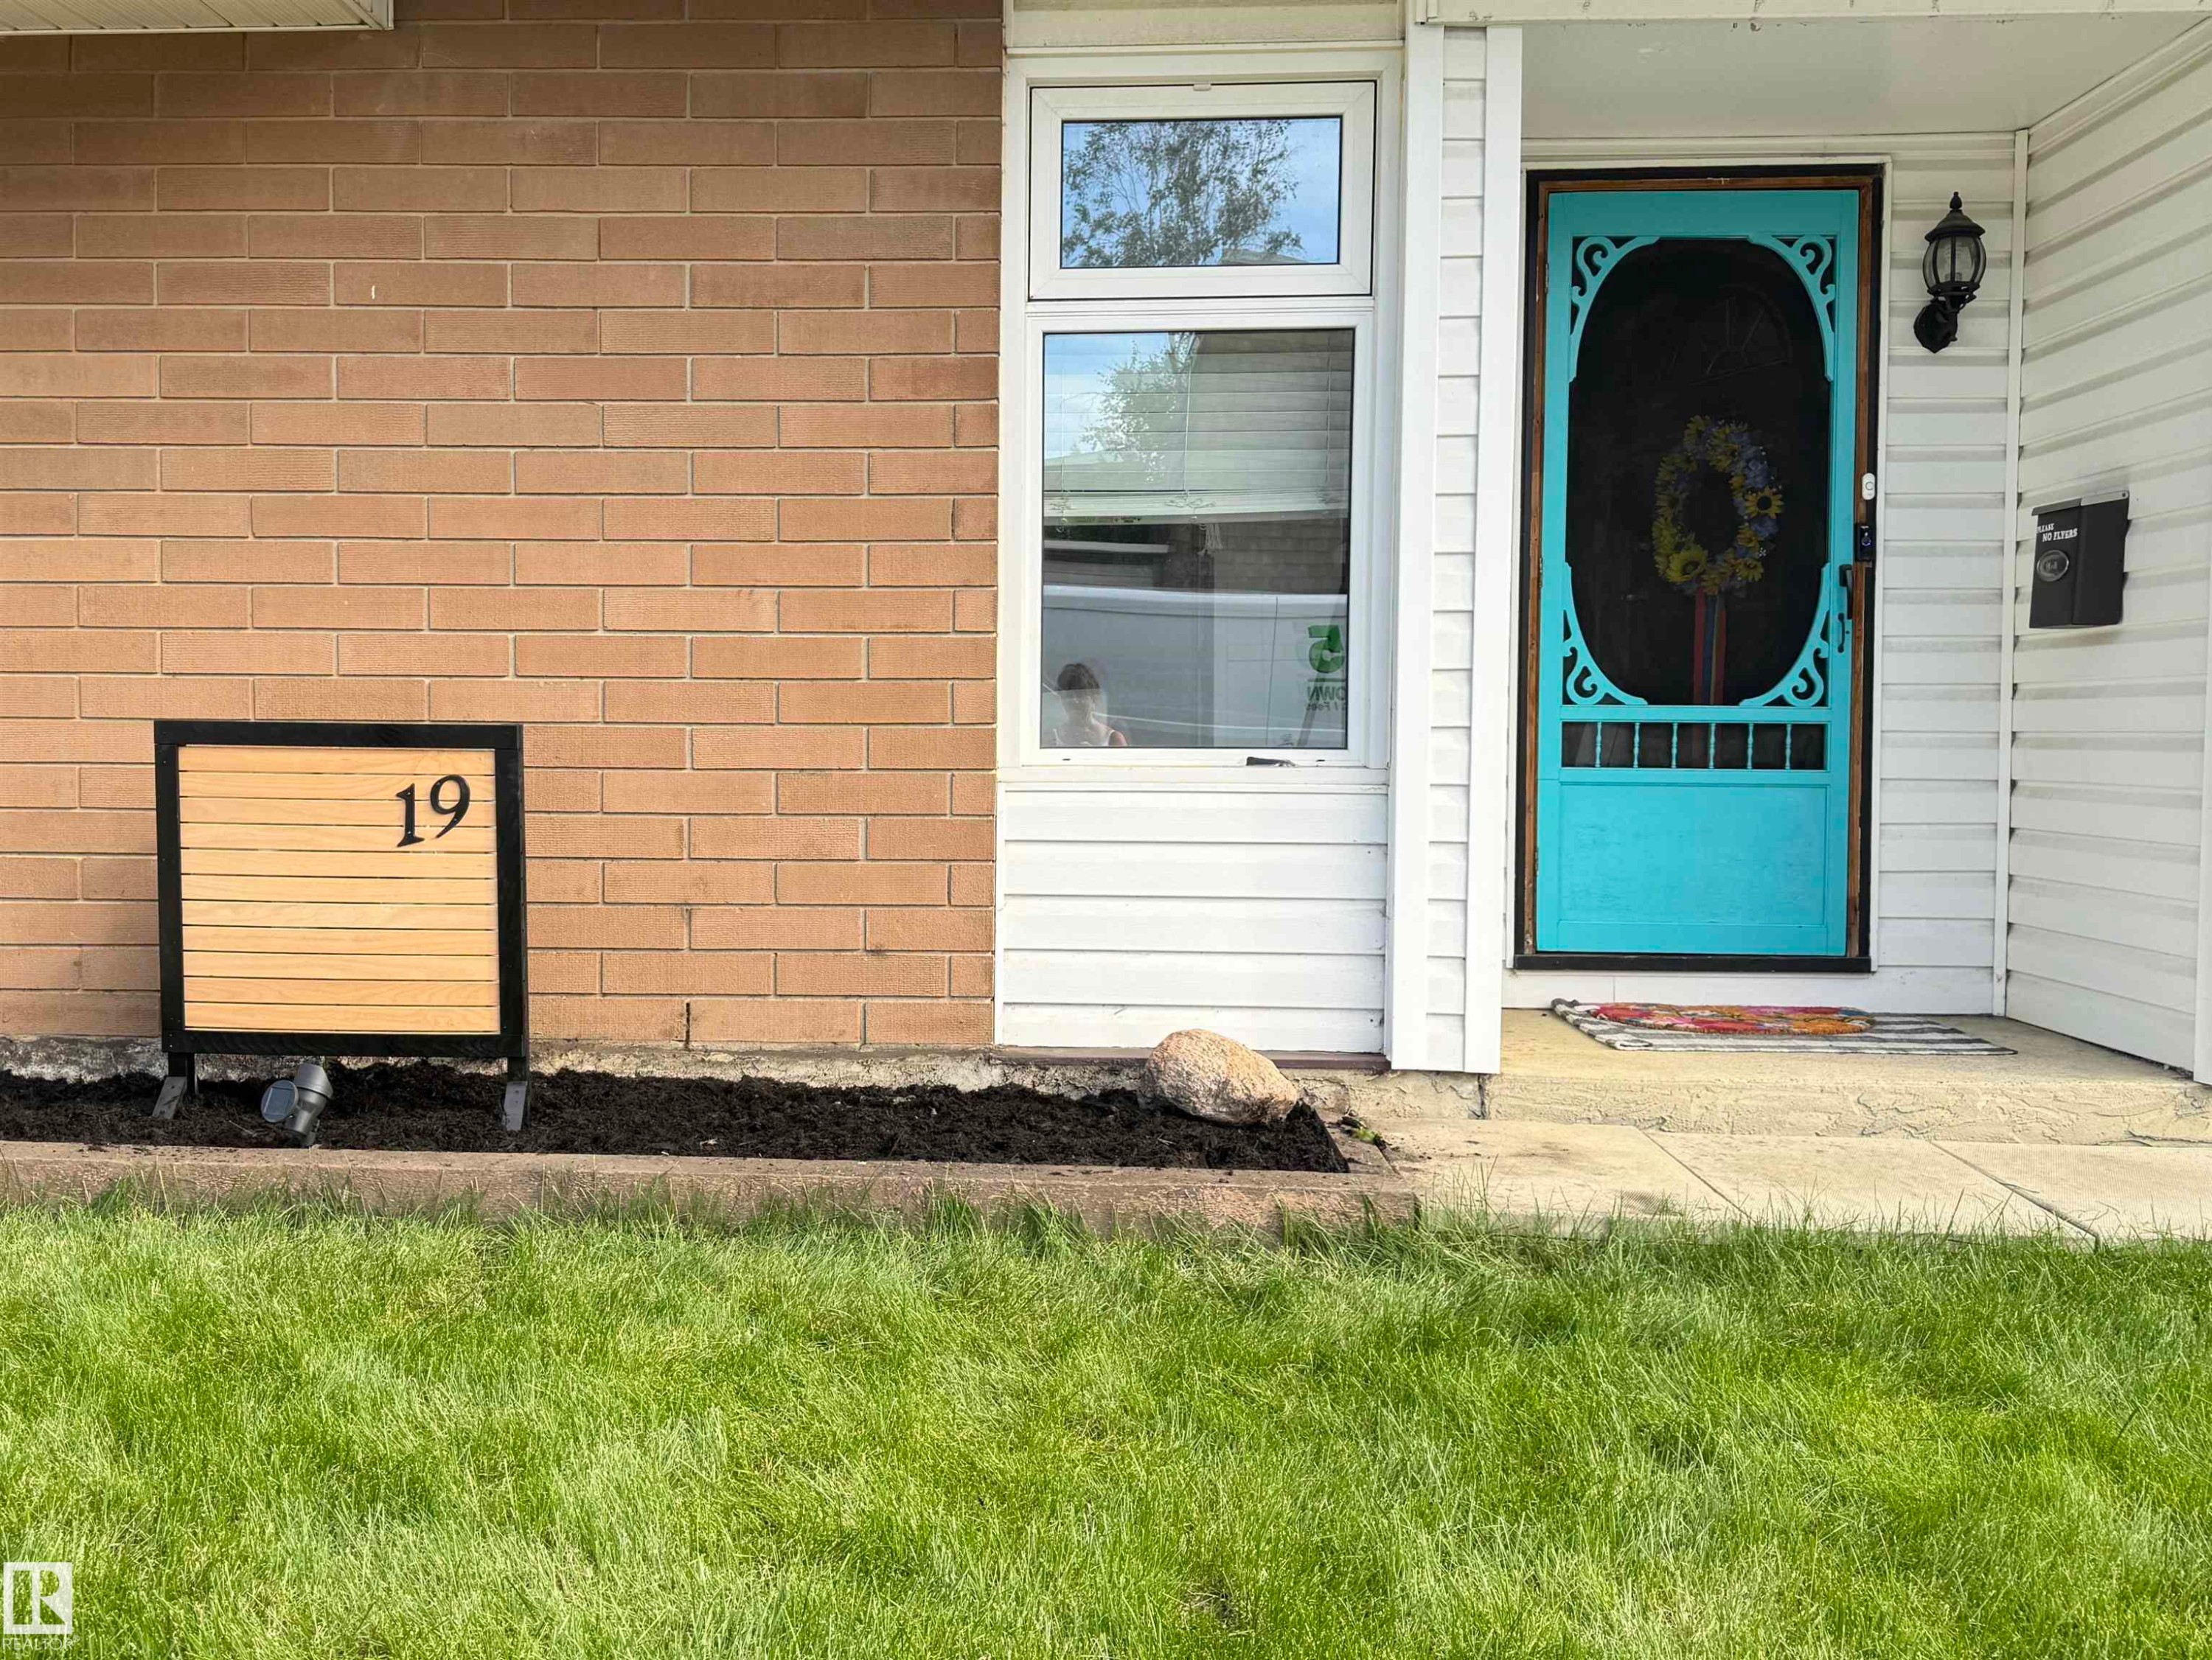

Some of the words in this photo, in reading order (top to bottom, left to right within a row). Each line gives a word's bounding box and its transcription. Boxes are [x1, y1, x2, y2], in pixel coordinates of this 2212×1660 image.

[2042, 531, 2052, 542] NO
[2053, 527, 2078, 540] FLYERS
[395, 774, 470, 847] 19
